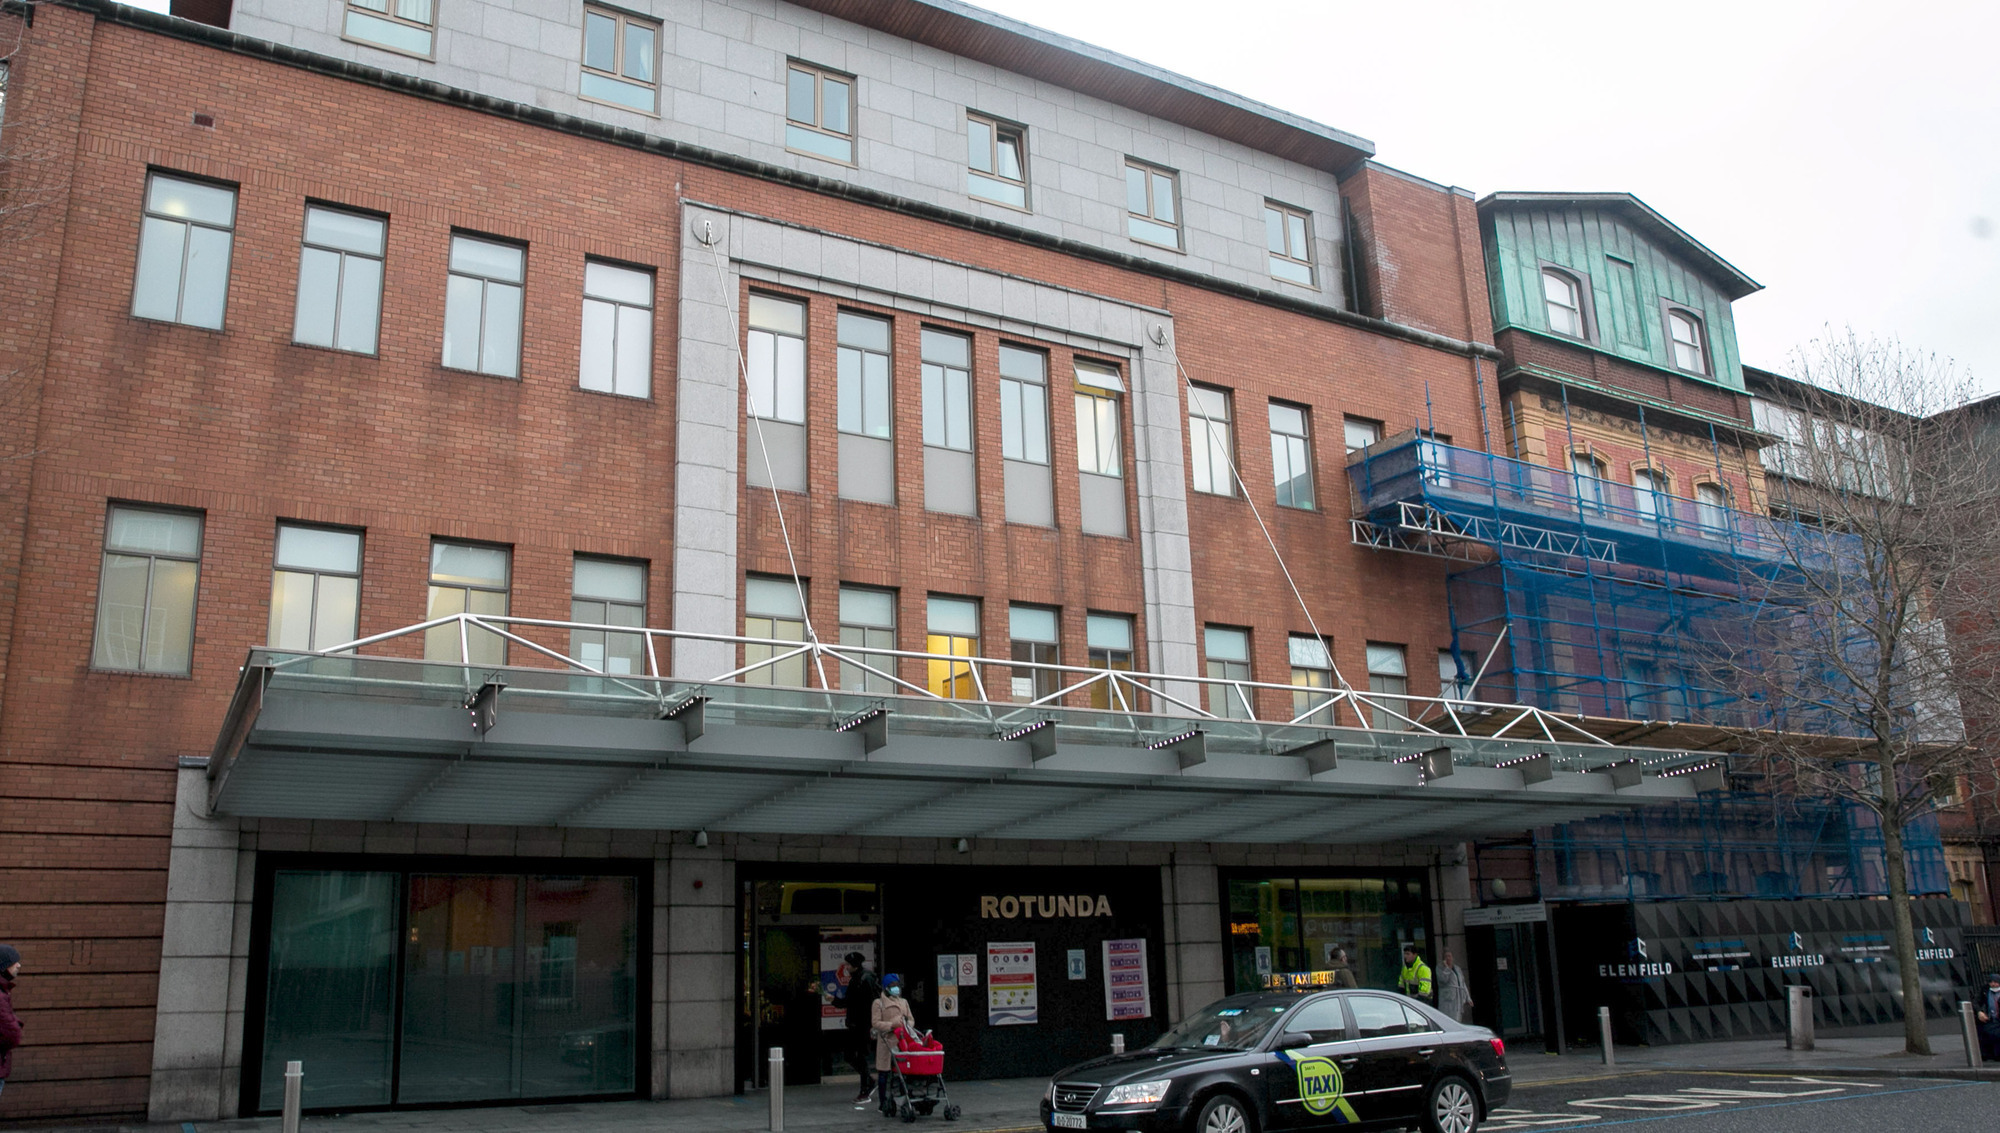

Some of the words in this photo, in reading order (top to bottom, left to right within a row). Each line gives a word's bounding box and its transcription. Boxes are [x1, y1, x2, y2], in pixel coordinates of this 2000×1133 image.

[980, 895, 1113, 919] ROTUNDA
[1771, 954, 1825, 968] ELENFIELD
[1914, 948, 1954, 960] LENFIELD
[1598, 962, 1672, 977] ELENFIELD
[1290, 973, 1310, 985] TAXI
[1304, 1074, 1337, 1096] TAXI
[1567, 1076, 1885, 1111] ONLY
